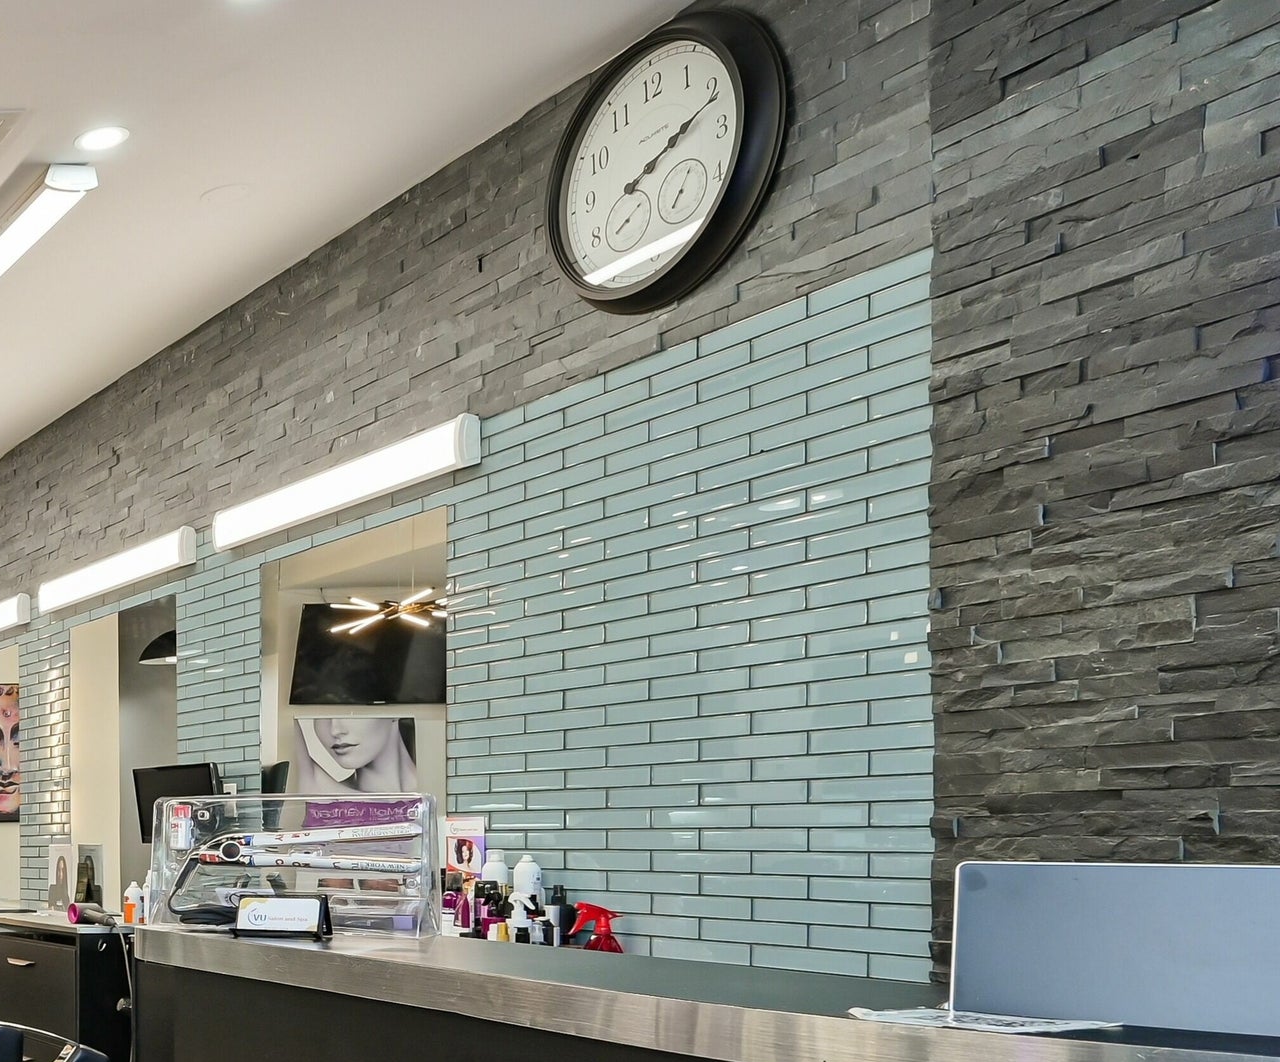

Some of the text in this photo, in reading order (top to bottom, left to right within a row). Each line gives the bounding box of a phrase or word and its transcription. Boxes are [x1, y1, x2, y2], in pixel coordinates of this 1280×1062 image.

[642, 71, 663, 104] 12
[682, 64, 691, 90] 1
[707, 76, 720, 101] 2
[612, 103, 630, 133] 11
[715, 114, 728, 139] 3
[590, 145, 609, 175] 10
[712, 160, 725, 183] 4
[585, 190, 595, 214] 9
[591, 226, 602, 248] 8
[253, 913, 267, 921] VU
